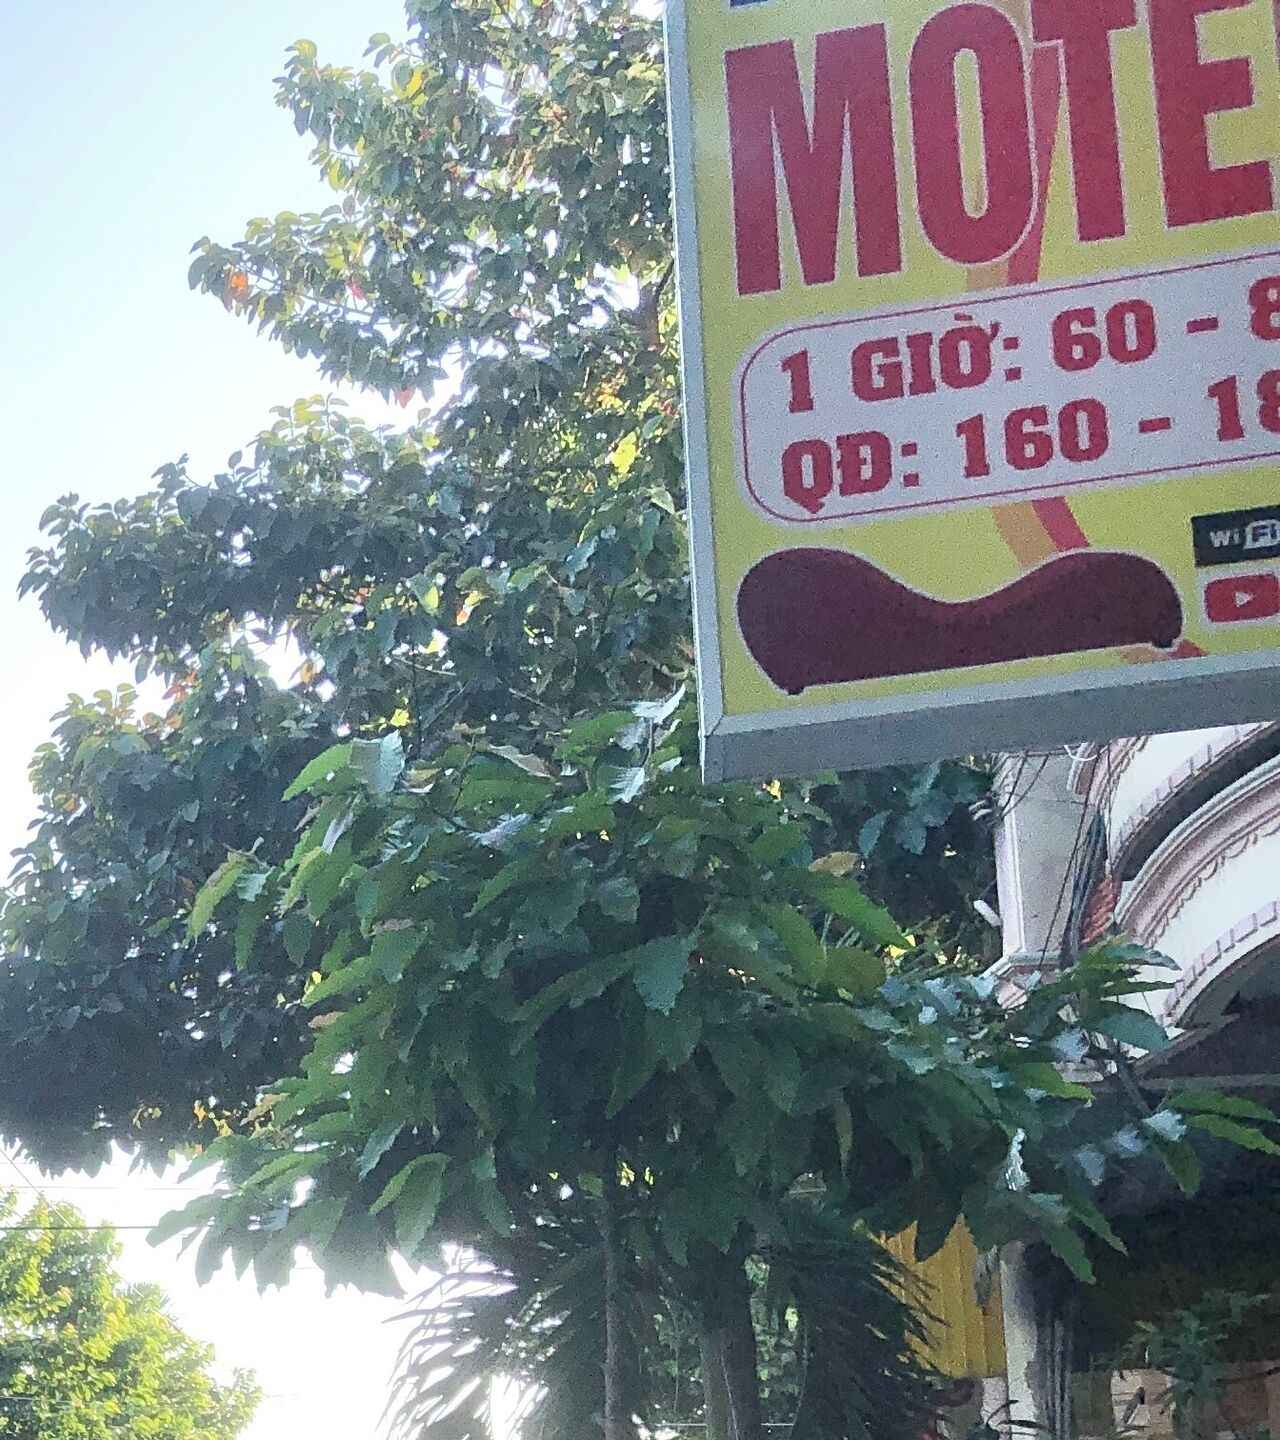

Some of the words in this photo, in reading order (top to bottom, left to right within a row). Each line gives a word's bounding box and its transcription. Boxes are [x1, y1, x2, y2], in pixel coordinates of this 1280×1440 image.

[725, 0, 1280, 297] MOTE
[781, 351, 814, 413] 1
[850, 313, 1021, 402] GIỜ:
[1051, 299, 1158, 371] 60
[782, 430, 918, 513] QĐ:
[954, 398, 1109, 477] 160
